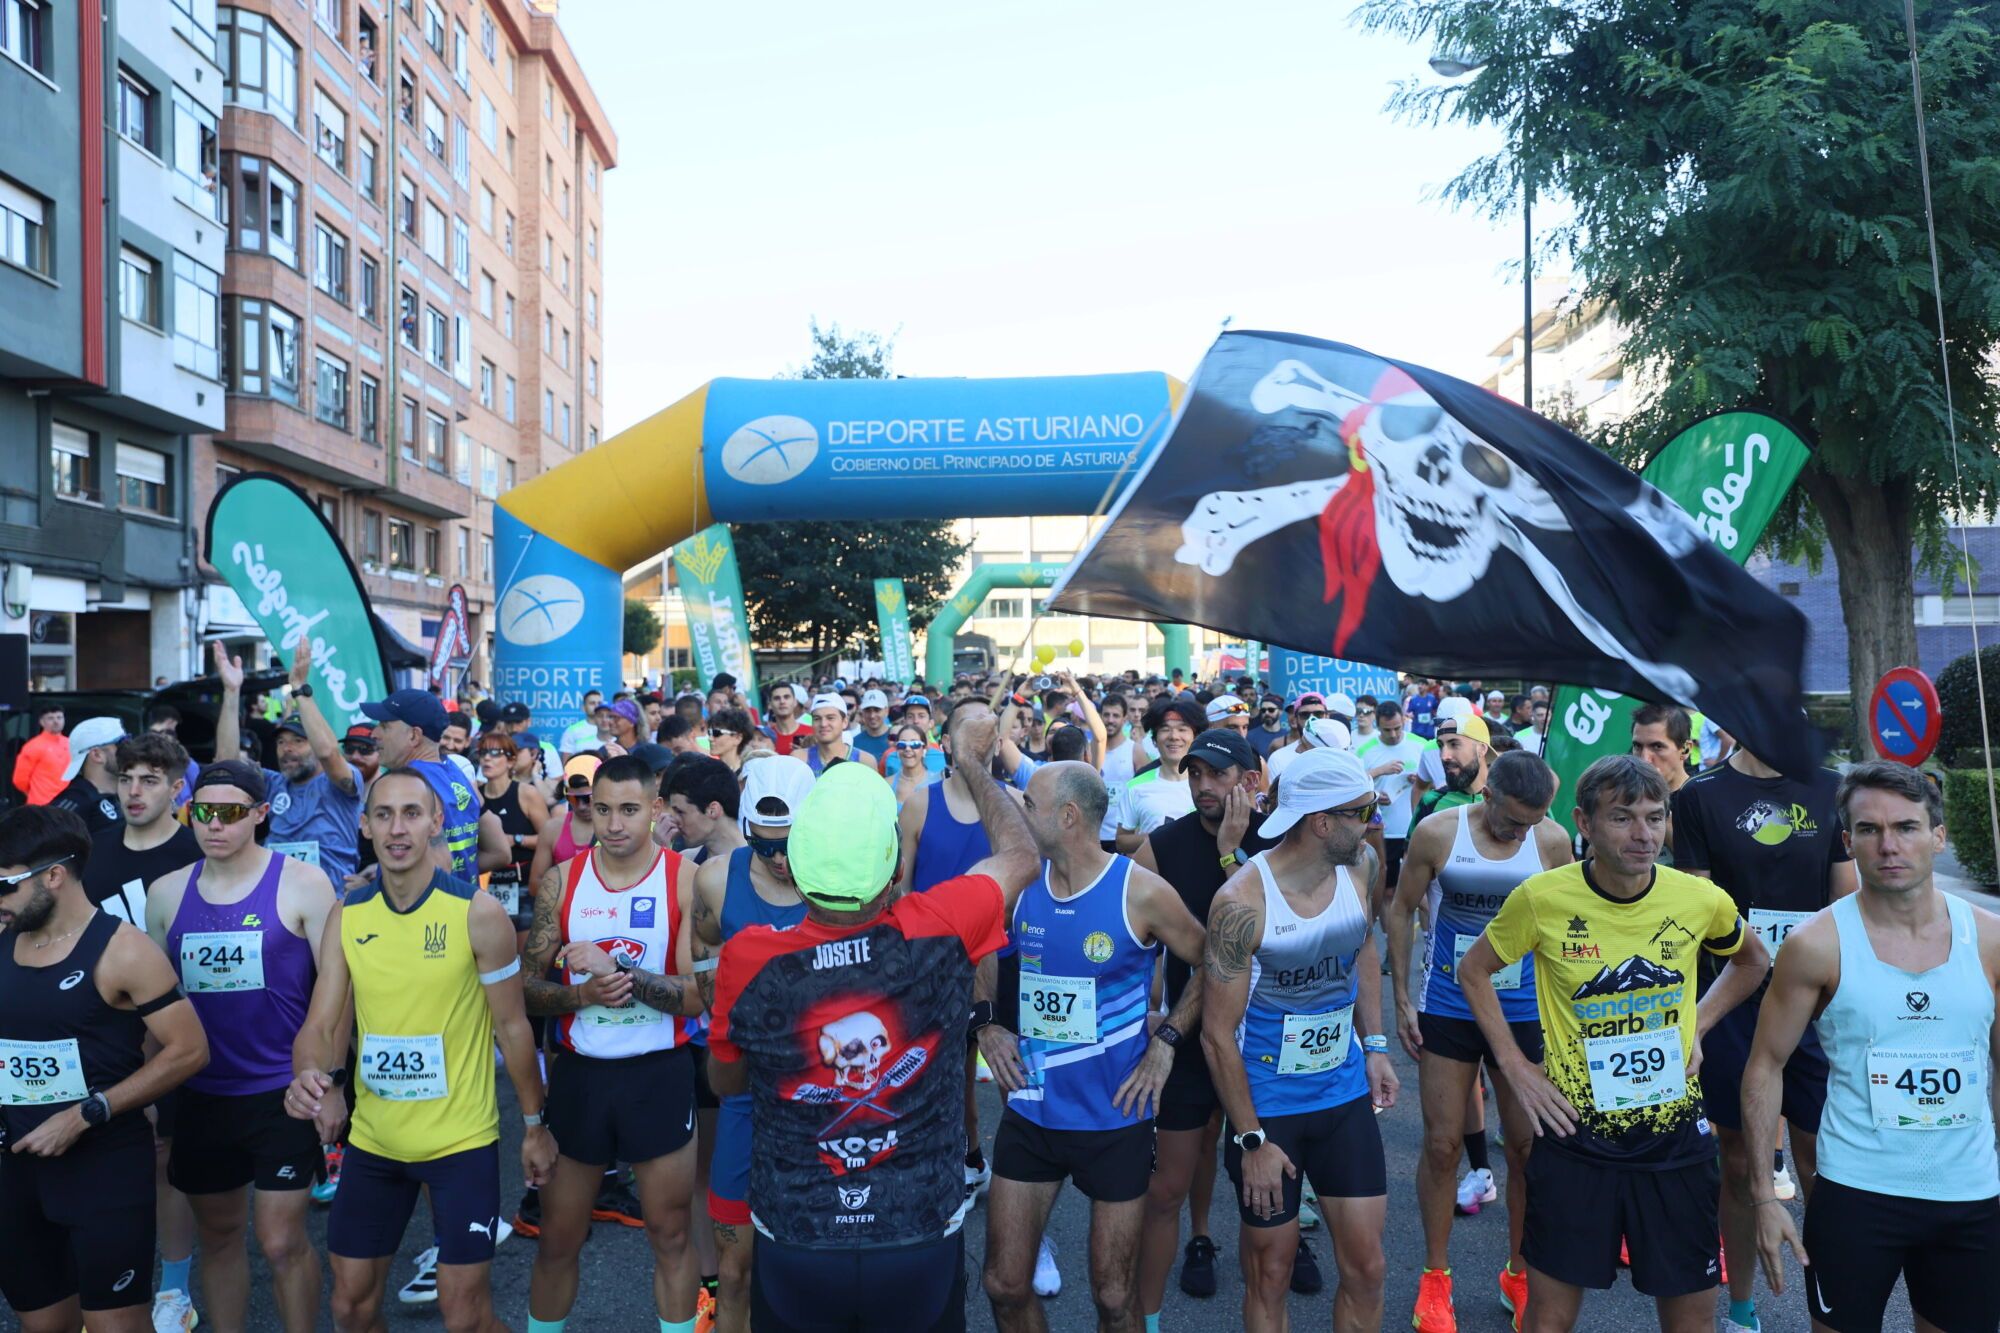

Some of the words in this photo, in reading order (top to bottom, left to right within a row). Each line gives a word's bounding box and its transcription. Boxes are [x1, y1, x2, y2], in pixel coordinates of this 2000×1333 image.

[828, 419, 965, 445] DEPORTE
[975, 413, 1144, 442] ASTURIANO
[831, 455, 909, 472] GOBIERNO
[913, 456, 941, 470] DEL
[943, 454, 1032, 470] PRINCIPADO
[1036, 454, 1055, 467] DE
[1061, 450, 1137, 467] ASTURIAS
[1286, 676, 1396, 698] ASTURIANO
[1028, 926, 1045, 936] ence
[199, 946, 244, 966] 244
[813, 937, 871, 970] JOSETE
[1033, 990, 1077, 1014] 387
[1573, 986, 1683, 1019] senderos
[1042, 1014, 1067, 1022] JESUS
[1300, 1023, 1341, 1049] 264
[1612, 1034, 1643, 1044] MARATÓN
[10, 1056, 60, 1078] 353
[377, 1051, 424, 1072] 243
[1609, 1048, 1665, 1078] 259
[389, 1072, 437, 1080] KUZMENKO
[1632, 1075, 1652, 1084] IBAI
[1895, 1068, 1961, 1095] 450
[1918, 1097, 1945, 1105] ERIC
[835, 1214, 875, 1224] FASTER
